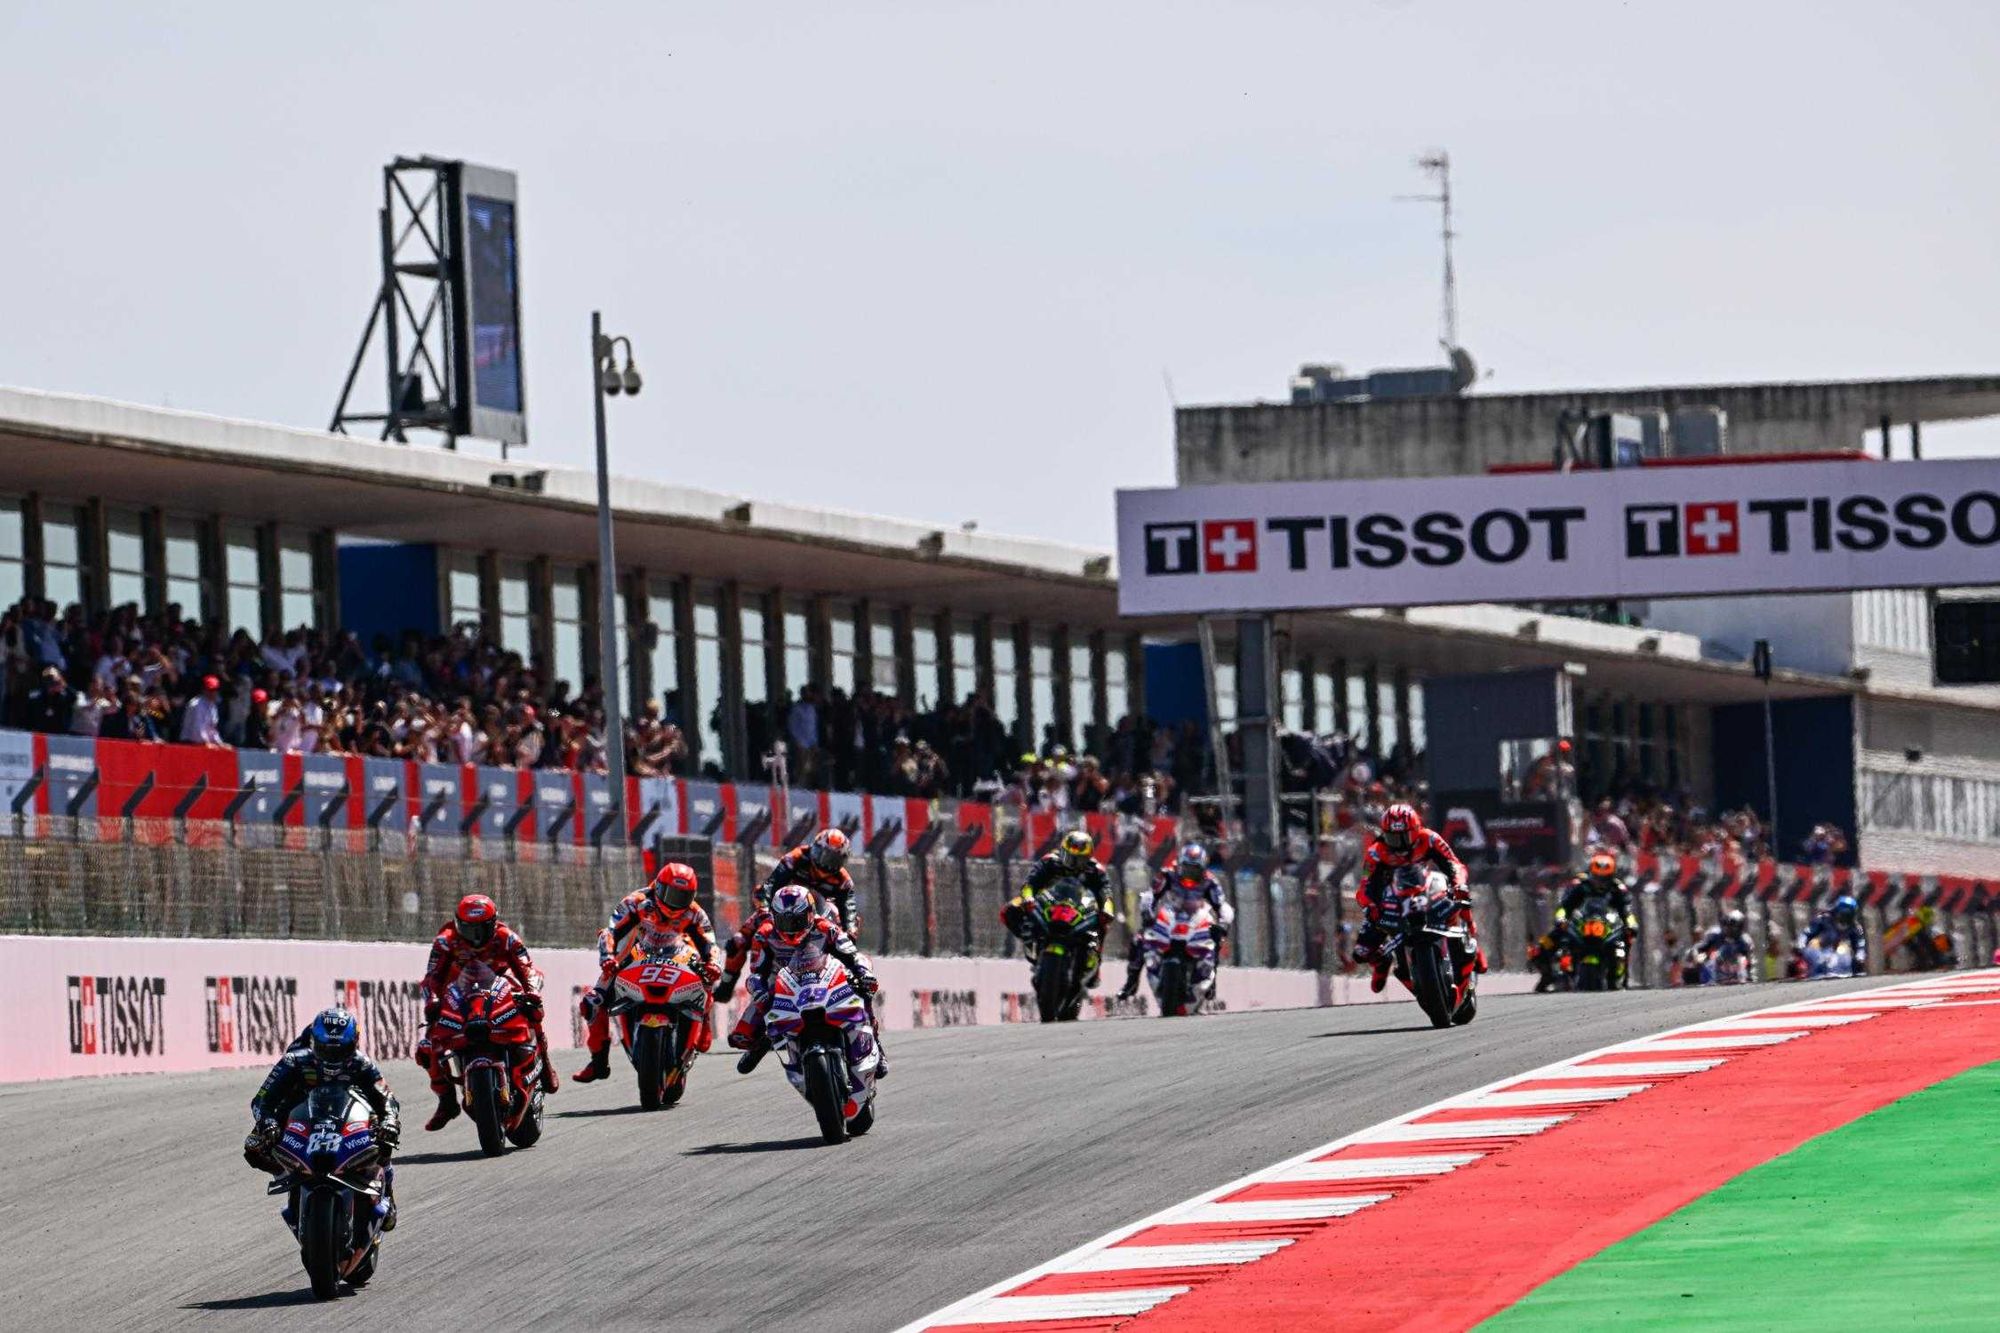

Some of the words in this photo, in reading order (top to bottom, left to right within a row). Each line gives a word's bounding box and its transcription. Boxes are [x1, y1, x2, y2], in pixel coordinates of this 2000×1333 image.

[1267, 507, 1587, 571] TISSOT
[1748, 490, 2000, 554] TISSO
[639, 967, 682, 986] 93
[96, 976, 166, 1057] TISSOT
[232, 977, 297, 1055] TISSOT
[438, 1017, 463, 1031] Lenovo
[491, 1007, 518, 1026] Lenovo
